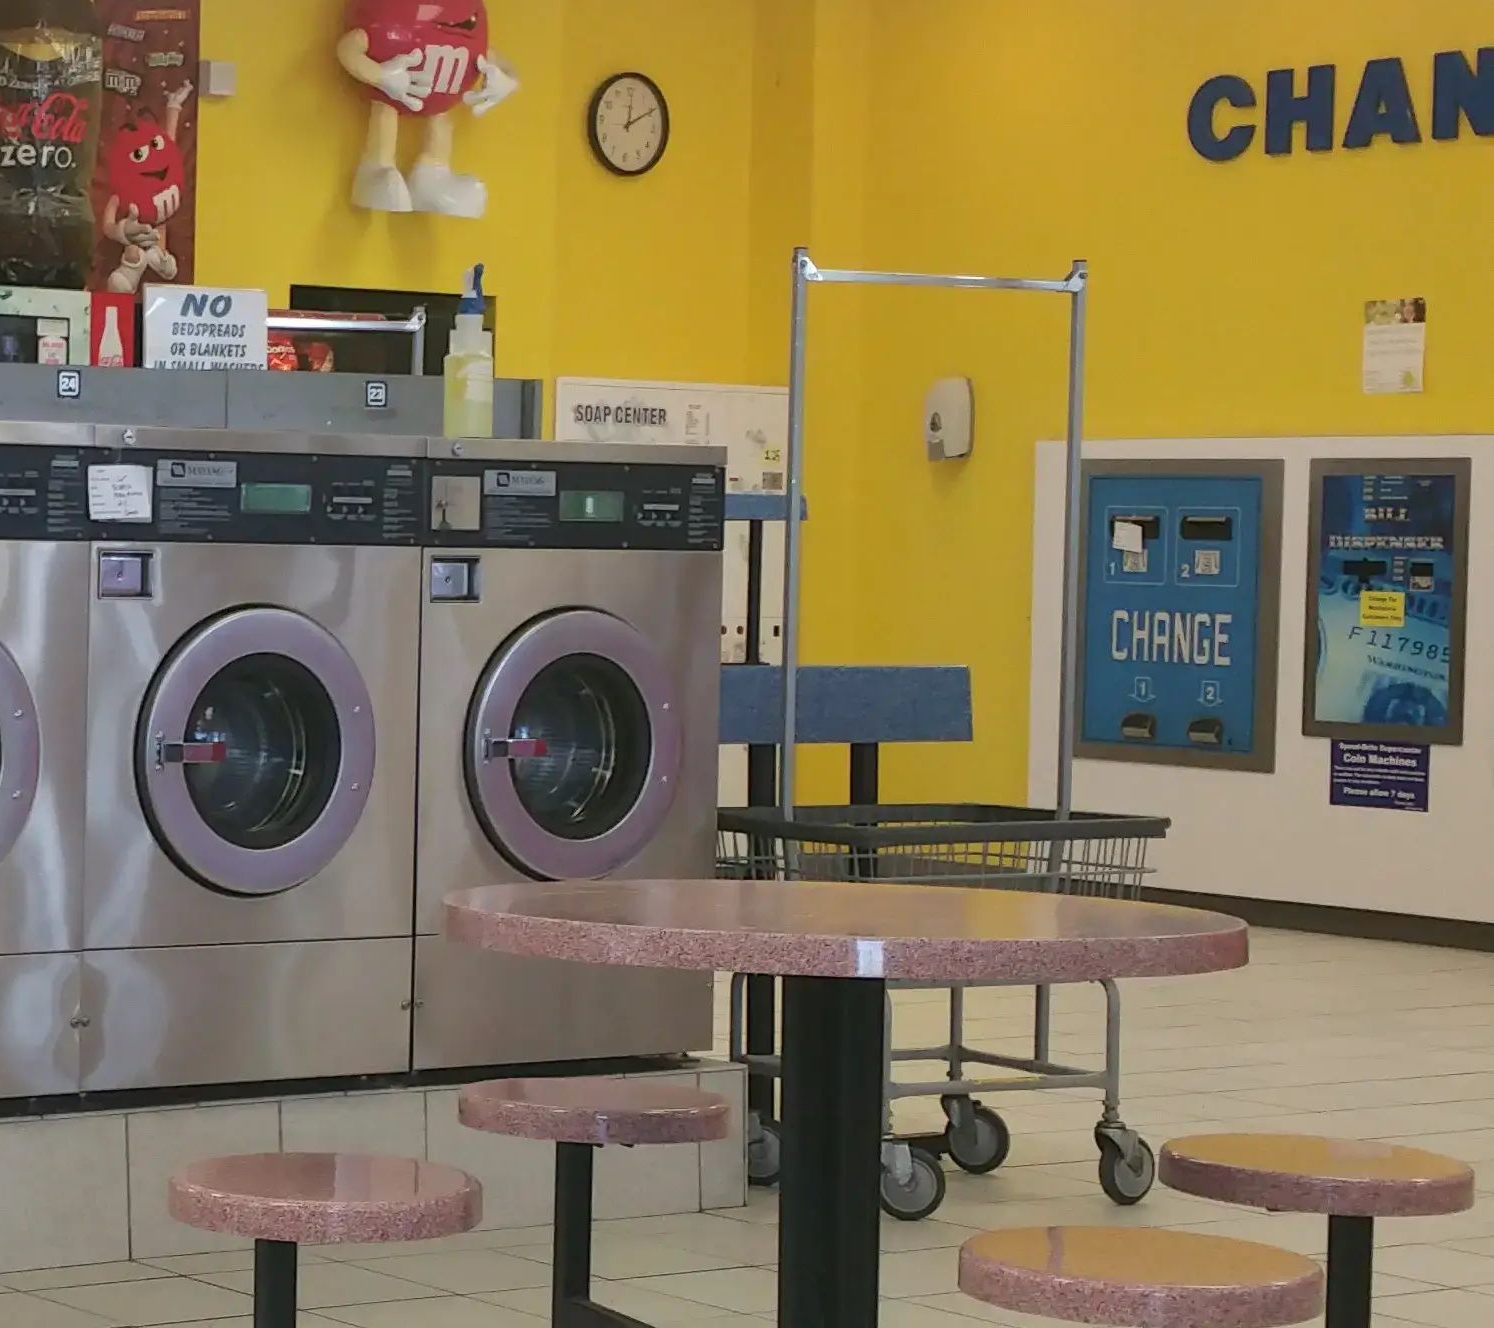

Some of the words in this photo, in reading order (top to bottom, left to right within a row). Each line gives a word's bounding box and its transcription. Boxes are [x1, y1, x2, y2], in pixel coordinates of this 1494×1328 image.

[1187, 47, 1494, 162] CHAN
[180, 293, 233, 318] NO
[171, 322, 246, 338] BEDSPREADS
[170, 342, 186, 357] OR
[190, 342, 247, 358] BLANKETS
[61, 377, 78, 391] 24
[575, 405, 611, 423] SOAP
[615, 406, 667, 425] CENTER
[1109, 561, 1116, 576] 1
[1180, 564, 1190, 578] 2
[1111, 609, 1233, 666] CHANGE
[1206, 686, 1215, 700] 2
[1343, 753, 1366, 765] Coin
[1367, 754, 1417, 768] Machines
